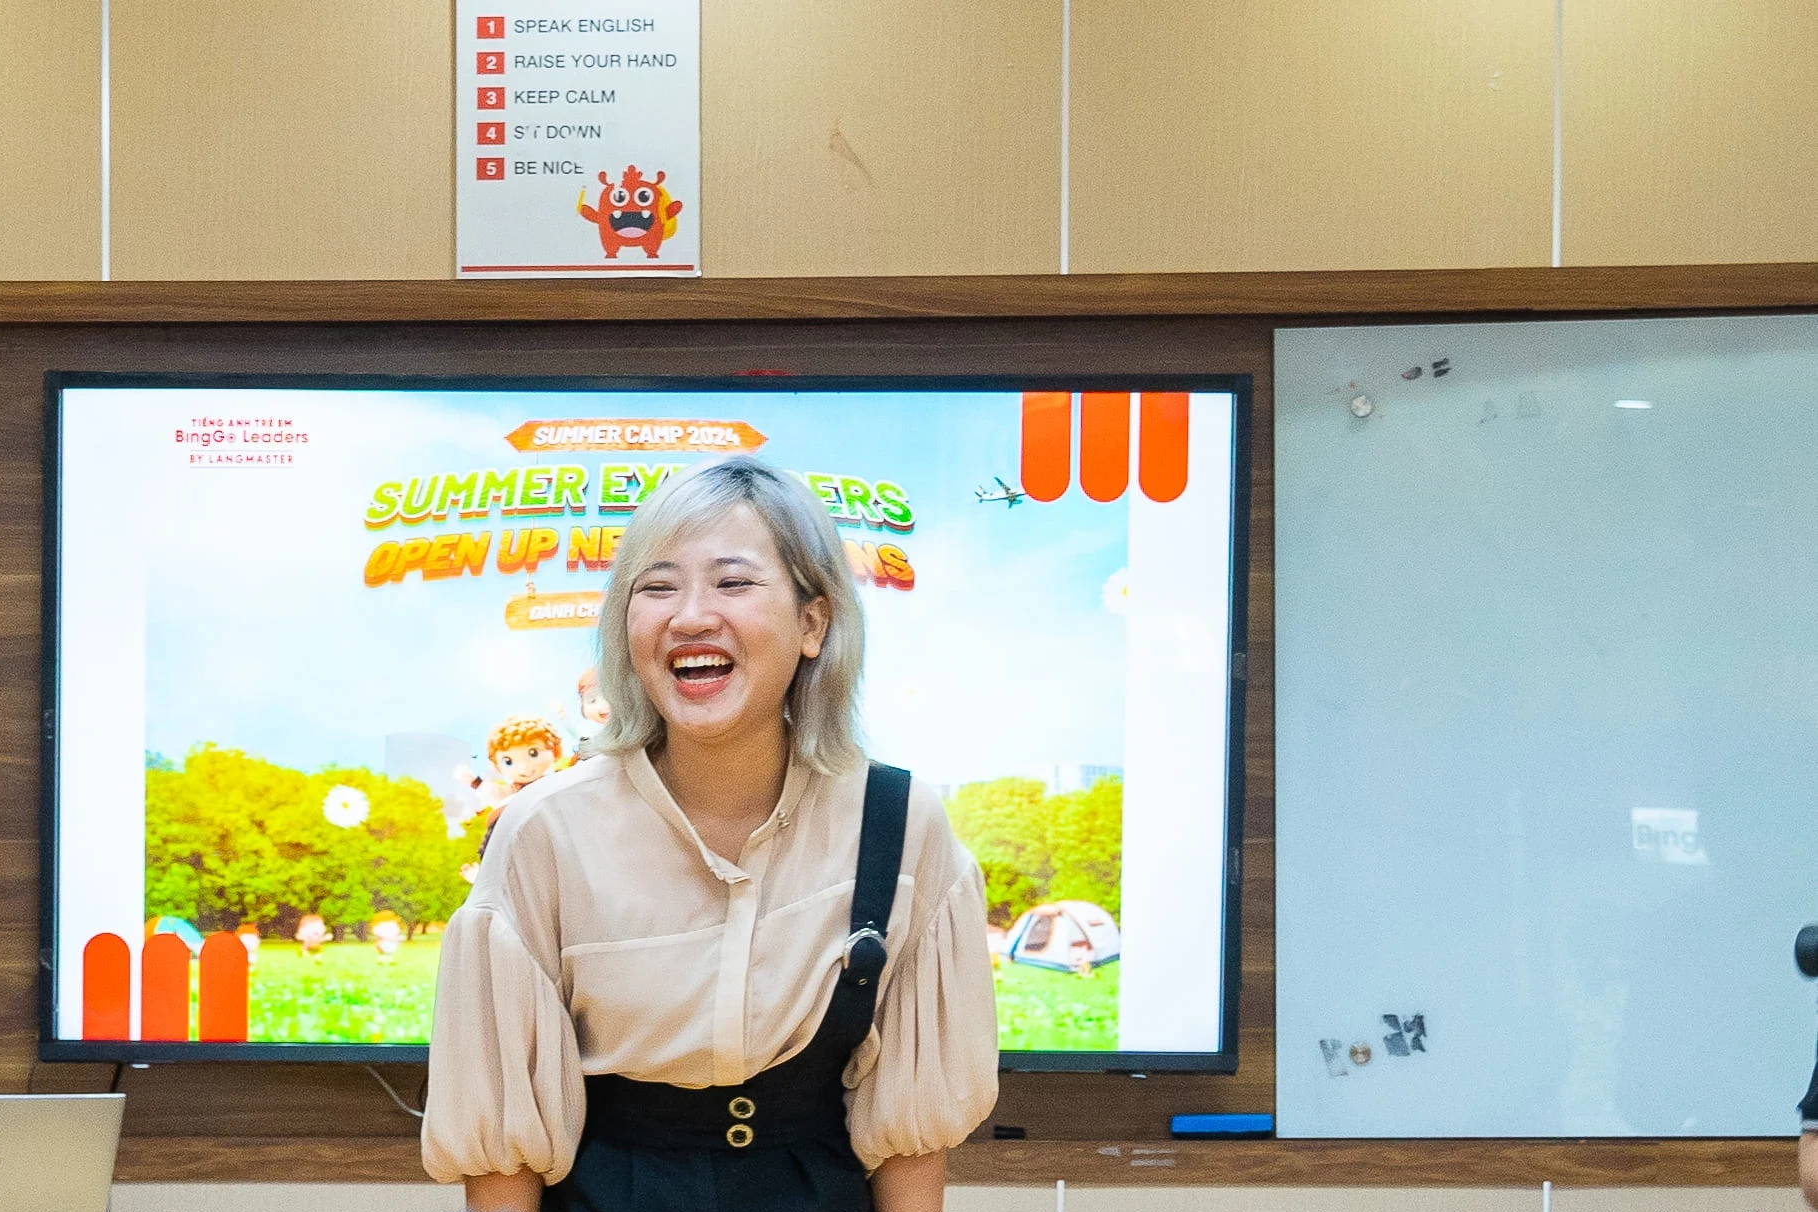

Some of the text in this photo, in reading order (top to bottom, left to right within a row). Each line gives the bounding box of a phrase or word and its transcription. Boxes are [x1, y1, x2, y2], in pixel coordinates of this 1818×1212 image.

[486, 18, 654, 34] 1 SPEAK ENGLISH
[486, 53, 677, 70] 2 RAISE YOUR HAND
[486, 89, 615, 105] 3 KEEP CALM
[486, 125, 601, 140] 4 ST DOWN
[486, 160, 584, 176] 5 BE NICE
[243, 430, 309, 443] Leaders
[533, 425, 741, 446] SUMMER CAMP 2024
[189, 454, 293, 464] BY LANGMASTER
[365, 463, 589, 531] SUMMER
[364, 526, 628, 588] OPEN UP NE
